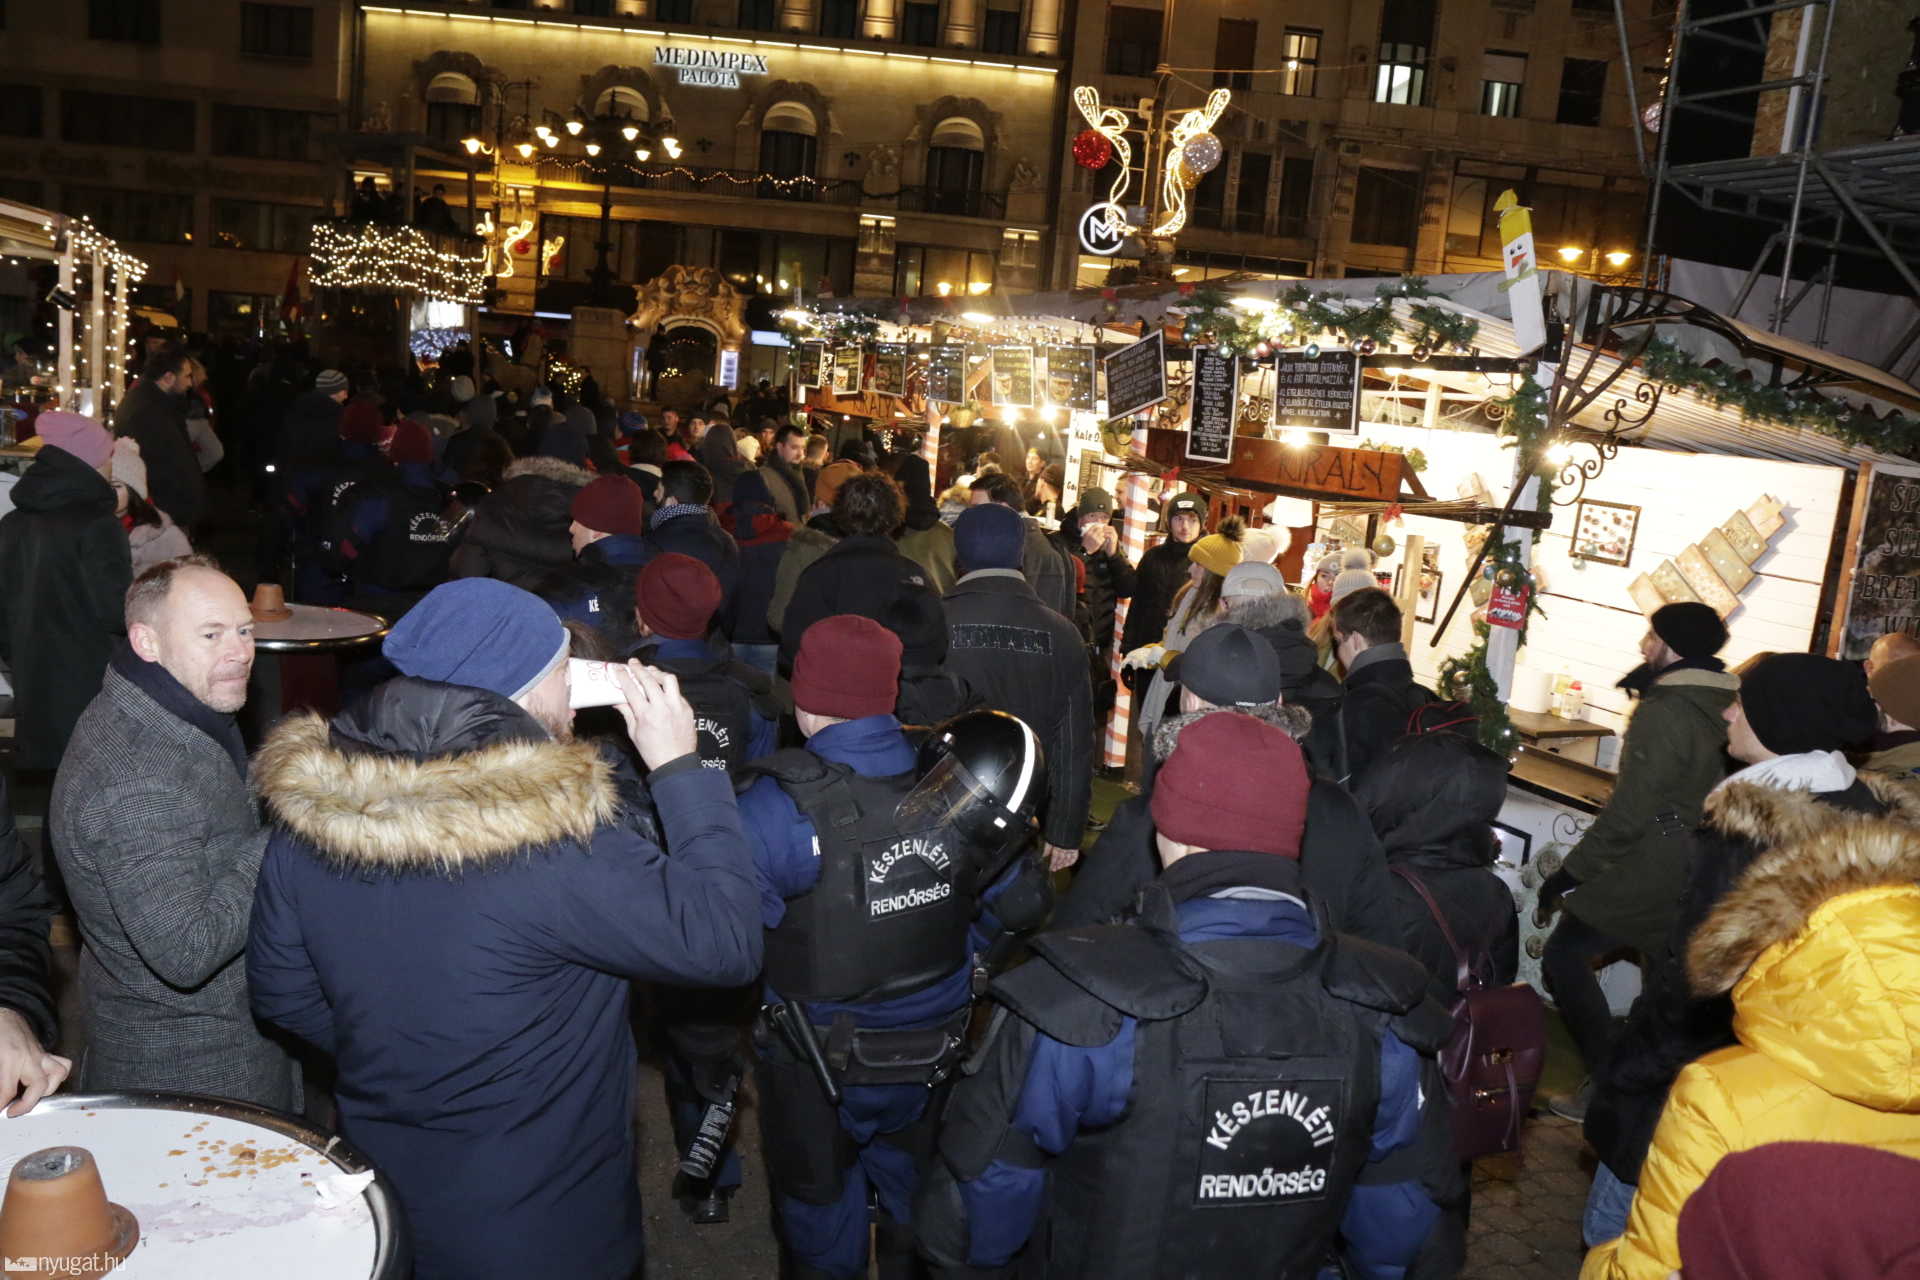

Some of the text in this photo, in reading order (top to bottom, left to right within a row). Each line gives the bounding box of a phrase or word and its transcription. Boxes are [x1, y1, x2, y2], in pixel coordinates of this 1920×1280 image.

[655, 46, 767, 74] MEDIMPEX
[680, 68, 738, 88] PALOTA
[1889, 483, 1920, 512] SP
[869, 838, 951, 884] KÉSZENLÉTI
[870, 881, 951, 916] RENDŐRSÉG
[1206, 1089, 1334, 1150] KÉSZENLÉTI
[1200, 1164, 1326, 1199] RENDŐRSÉG
